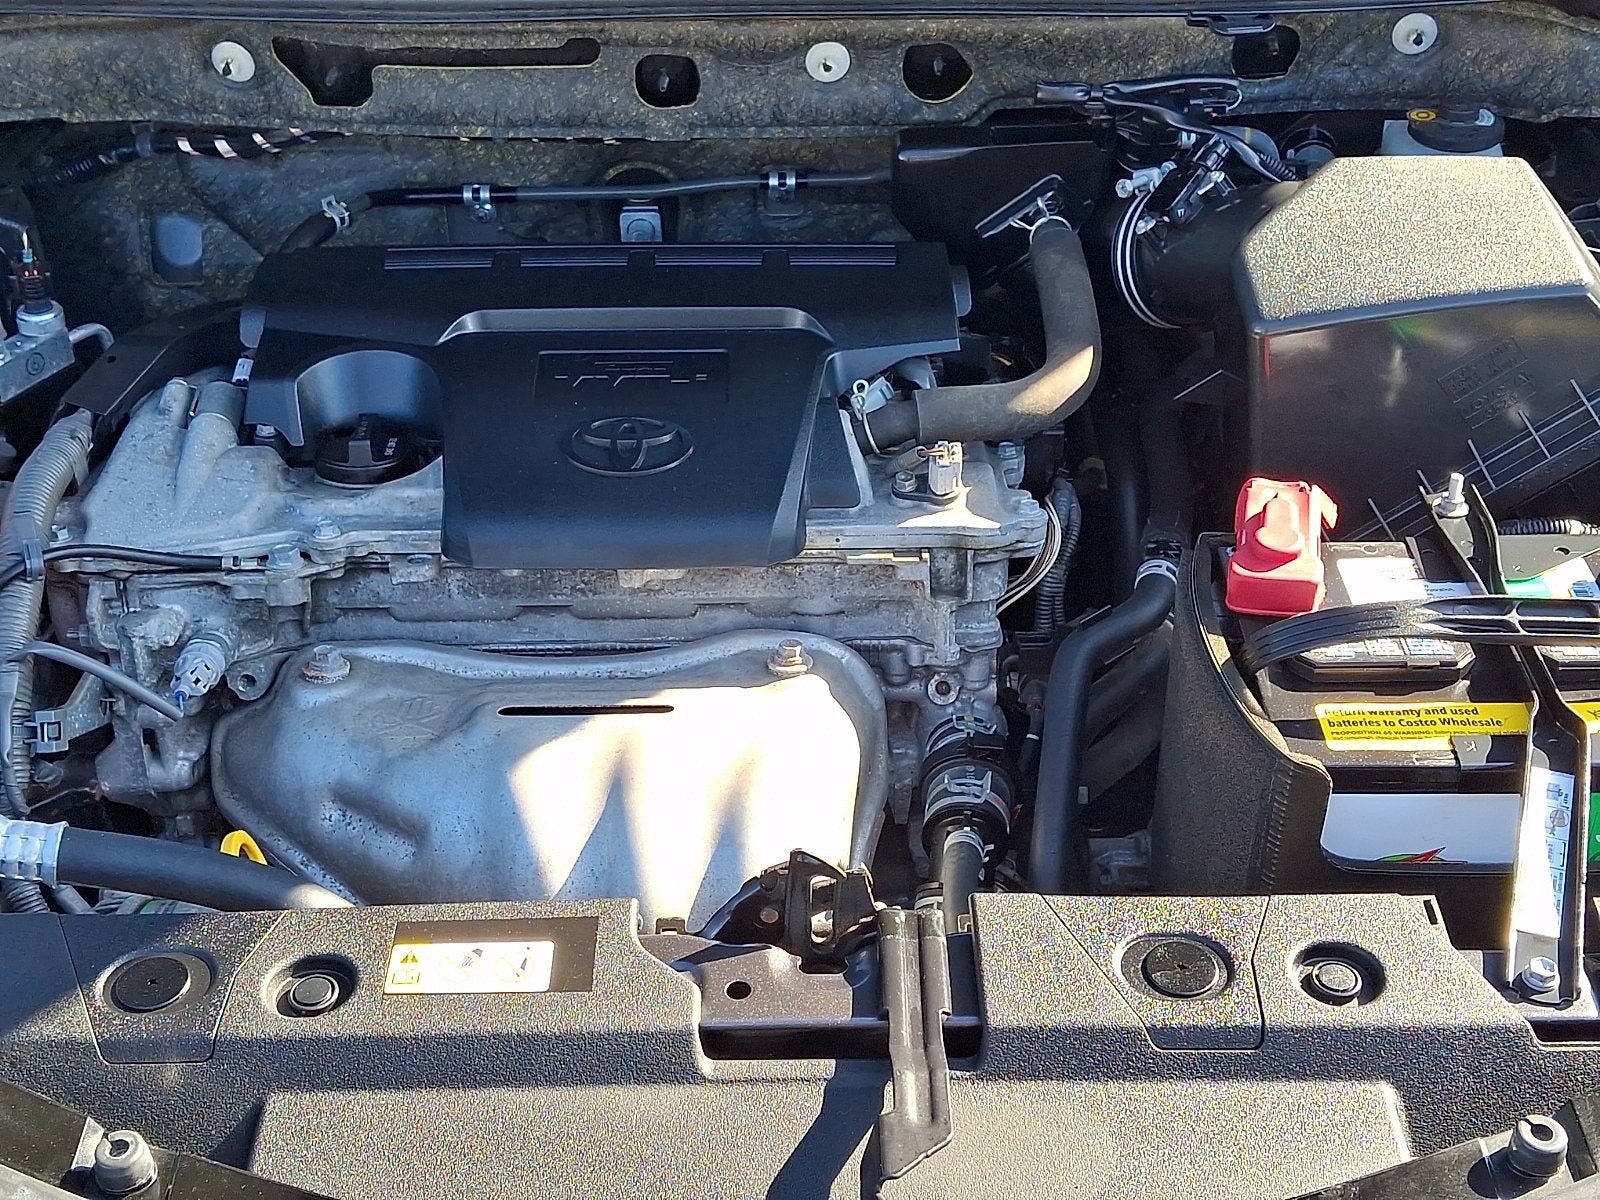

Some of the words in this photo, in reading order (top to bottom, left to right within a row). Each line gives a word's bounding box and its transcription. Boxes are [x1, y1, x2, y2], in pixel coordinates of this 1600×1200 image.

[1367, 709, 1421, 718] warranty
[1424, 707, 1447, 715] and
[1450, 707, 1479, 715] used
[1327, 718, 1381, 727] batteries
[1383, 719, 1396, 727] to
[1398, 718, 1437, 727] Costco
[1438, 717, 1503, 727] Wholesale
